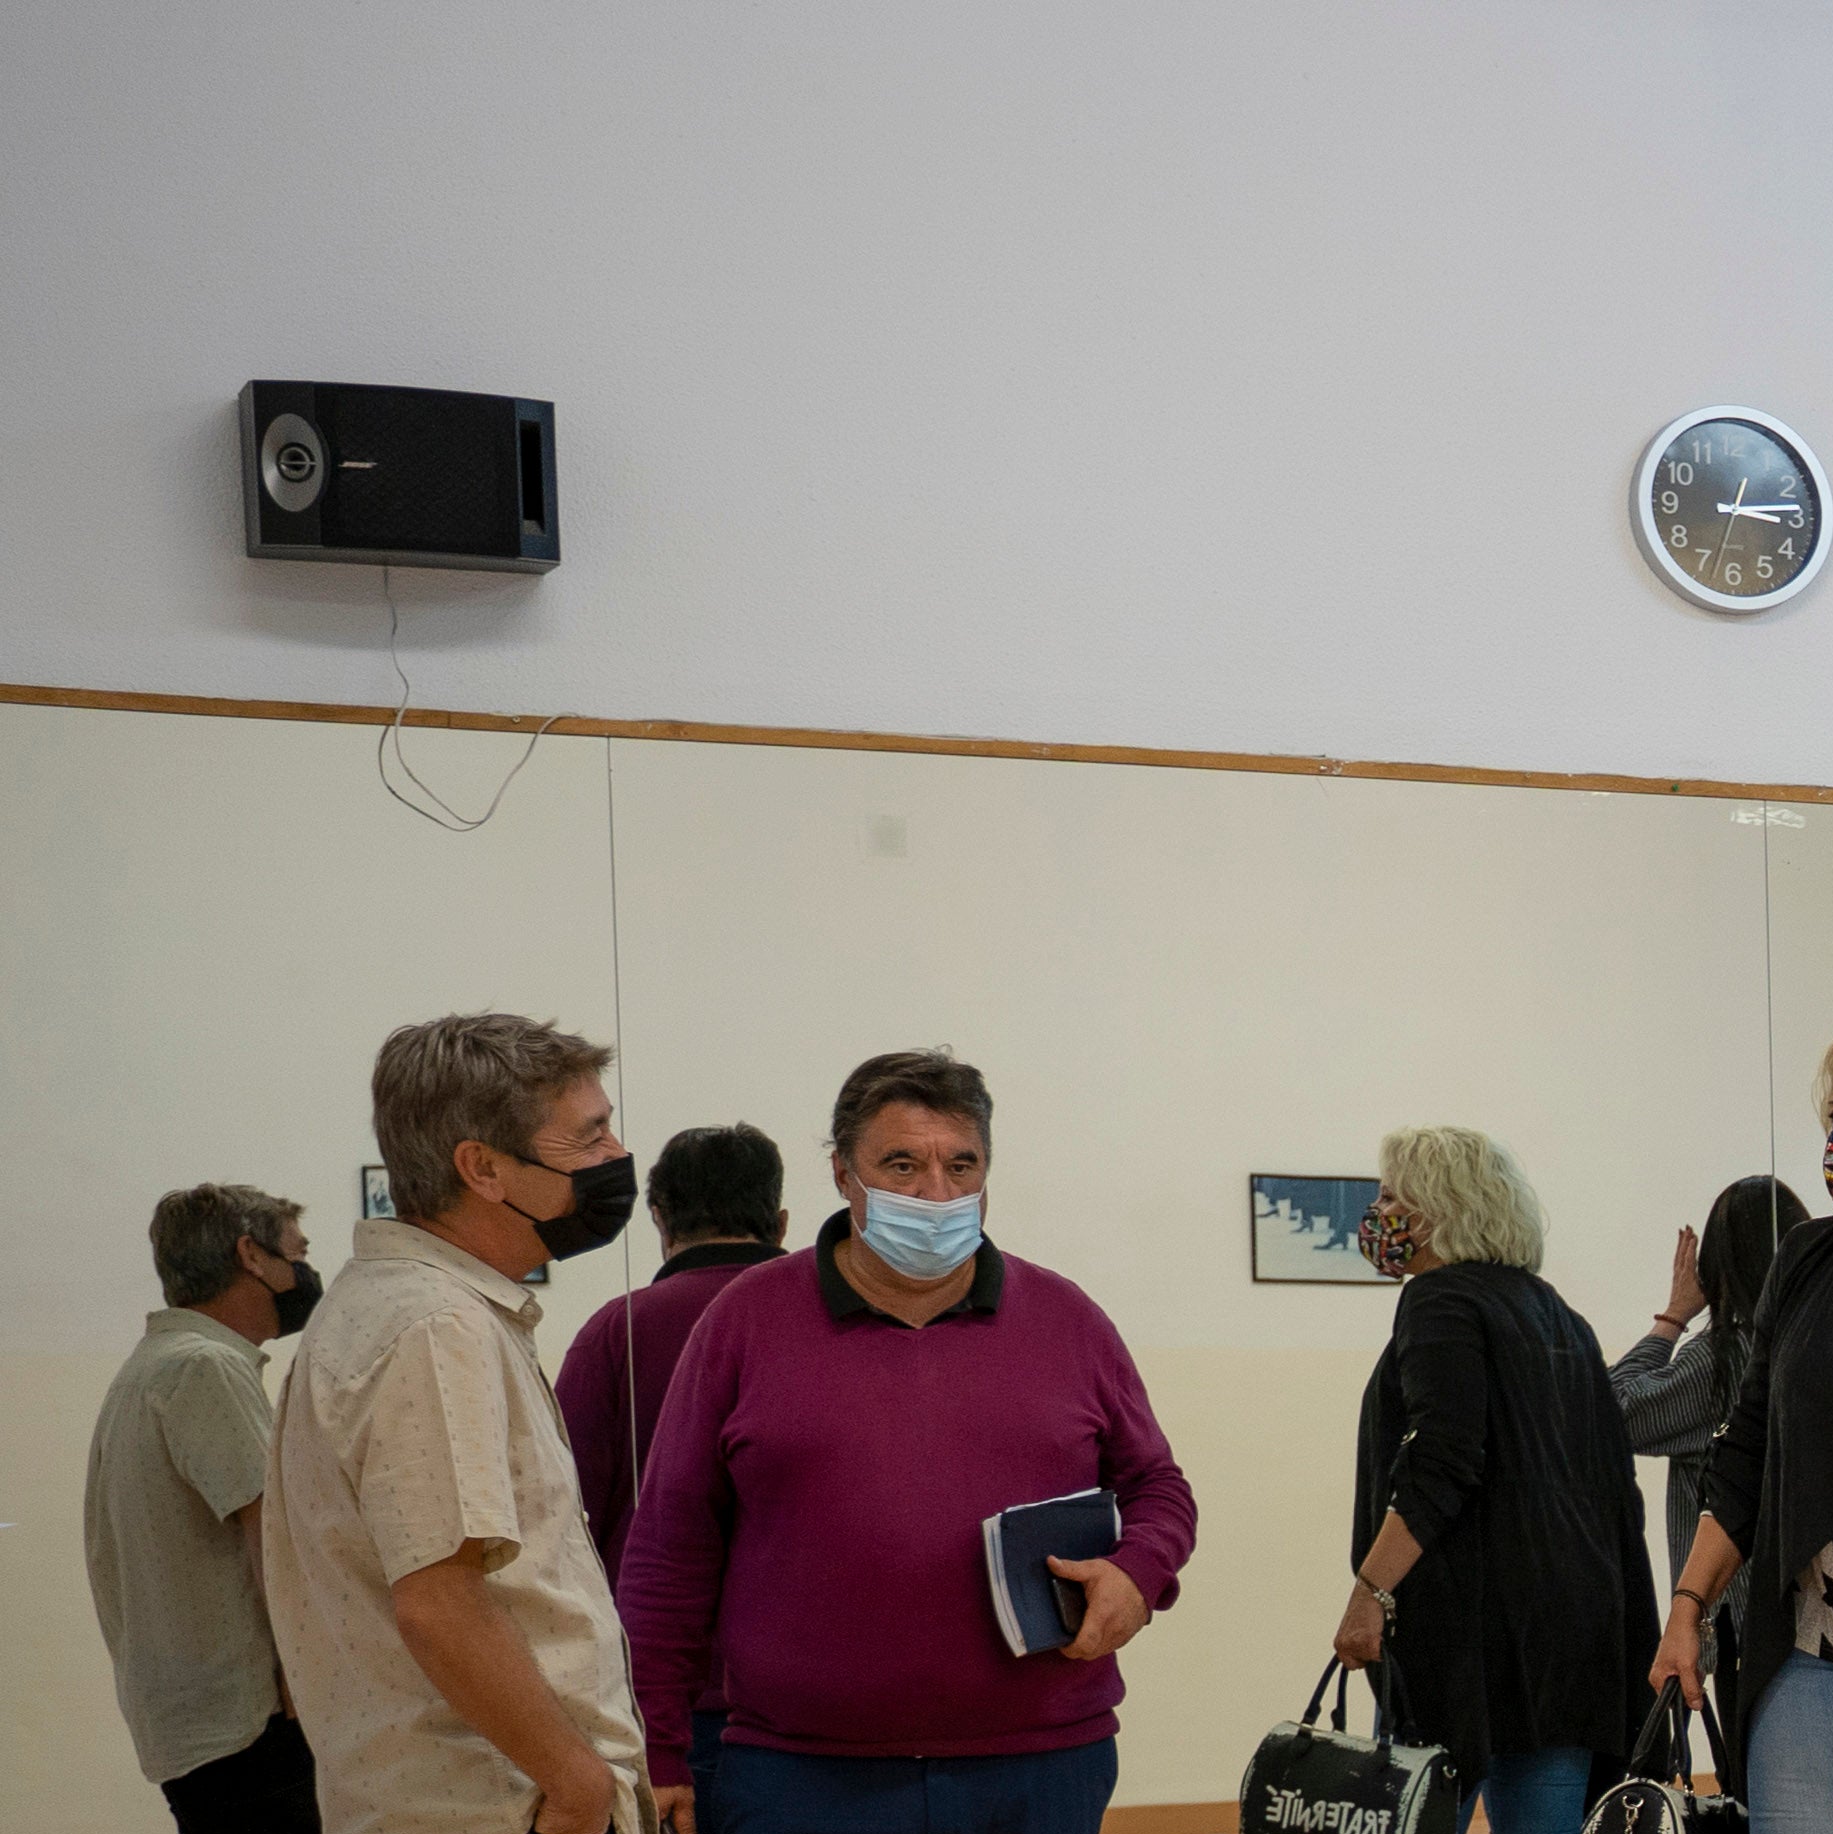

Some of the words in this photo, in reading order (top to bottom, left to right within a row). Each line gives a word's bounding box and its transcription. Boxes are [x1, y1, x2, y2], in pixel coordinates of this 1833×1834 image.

[1692, 441, 1712, 464] 11
[1668, 461, 1694, 485] 10
[1780, 475, 1797, 498] 2
[1661, 491, 1679, 514] 9
[1788, 506, 1805, 528] 3
[1671, 525, 1688, 548] 8
[1695, 548, 1712, 572] 7
[1777, 537, 1796, 560] 4
[1724, 562, 1742, 585] 6
[1756, 556, 1774, 578] 5
